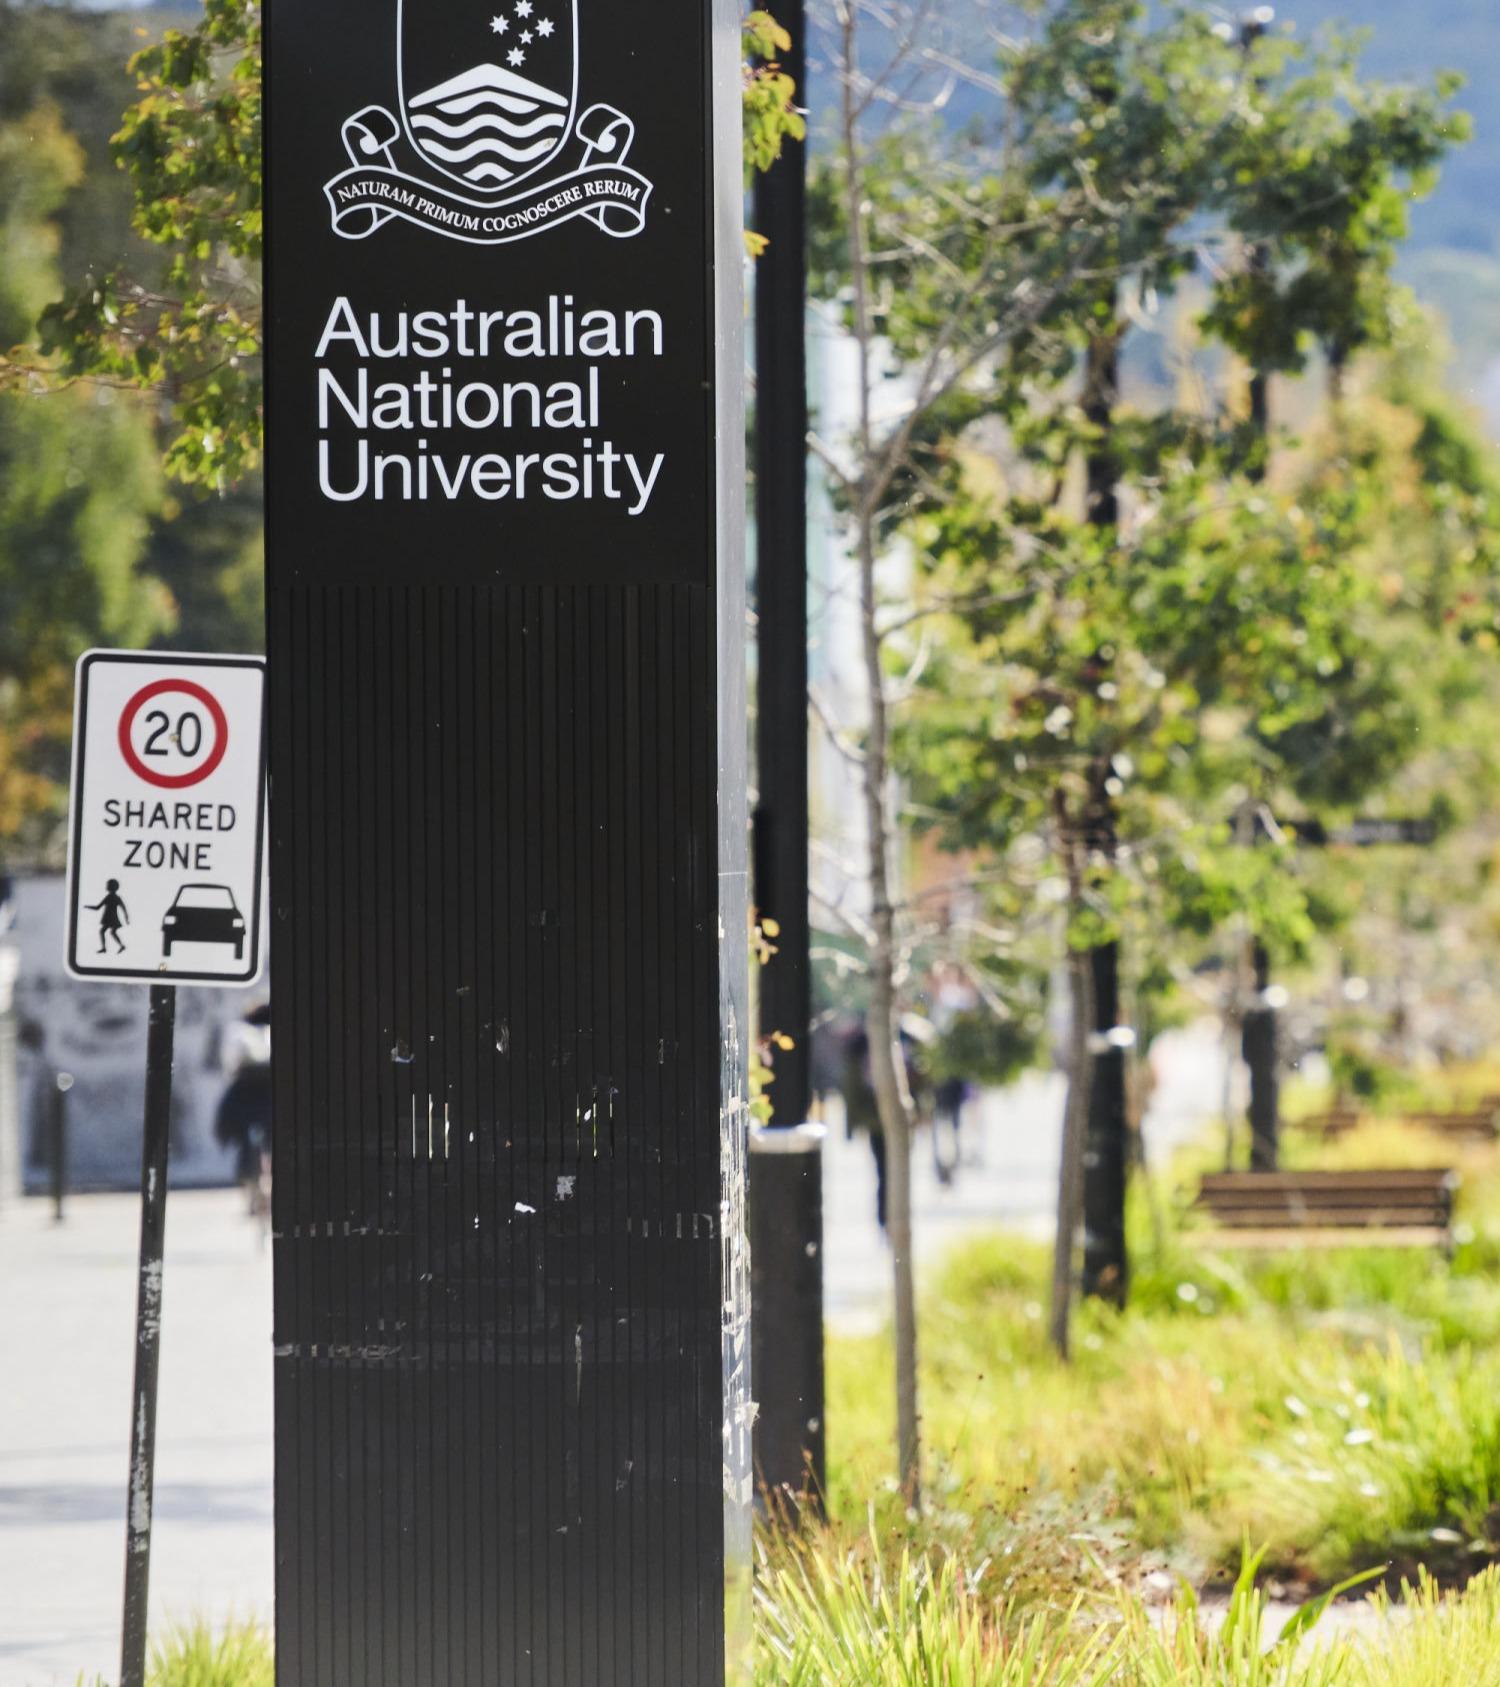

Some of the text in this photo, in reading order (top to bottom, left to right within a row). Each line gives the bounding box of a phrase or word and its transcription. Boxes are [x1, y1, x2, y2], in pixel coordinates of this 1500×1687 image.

[337, 180, 640, 232] NATURAM PRIMUM COGNOSCERE RERUM
[315, 295, 663, 358] Australian
[318, 366, 599, 430] National
[318, 437, 664, 516] University
[144, 710, 202, 758] 20
[103, 799, 236, 832] SHARED
[123, 840, 212, 871] ZONE
